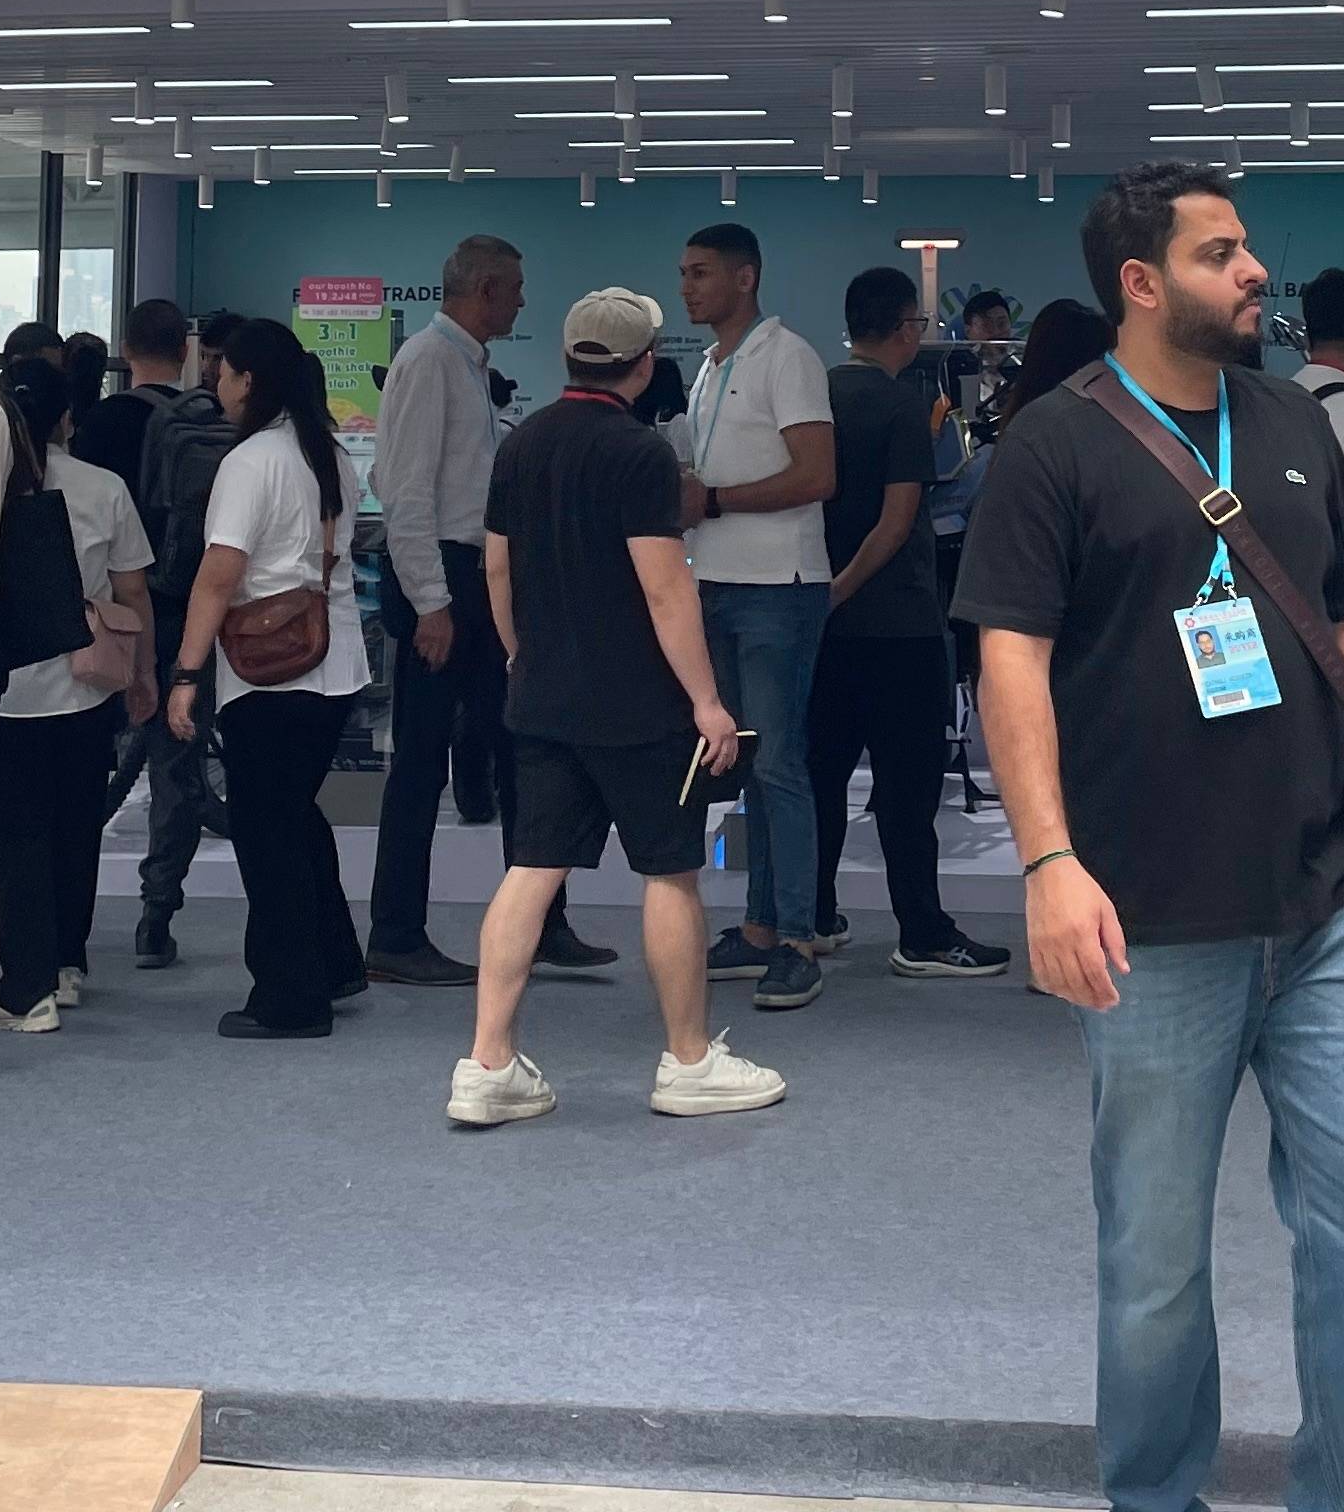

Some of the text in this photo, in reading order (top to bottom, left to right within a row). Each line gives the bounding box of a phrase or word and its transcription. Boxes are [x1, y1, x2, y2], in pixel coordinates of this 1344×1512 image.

[383, 286, 442, 302] TRADE
[318, 323, 357, 340] 3 in 1
[309, 348, 356, 358] oothie
[324, 362, 373, 373] ilk shak
[328, 378, 358, 389] slush
